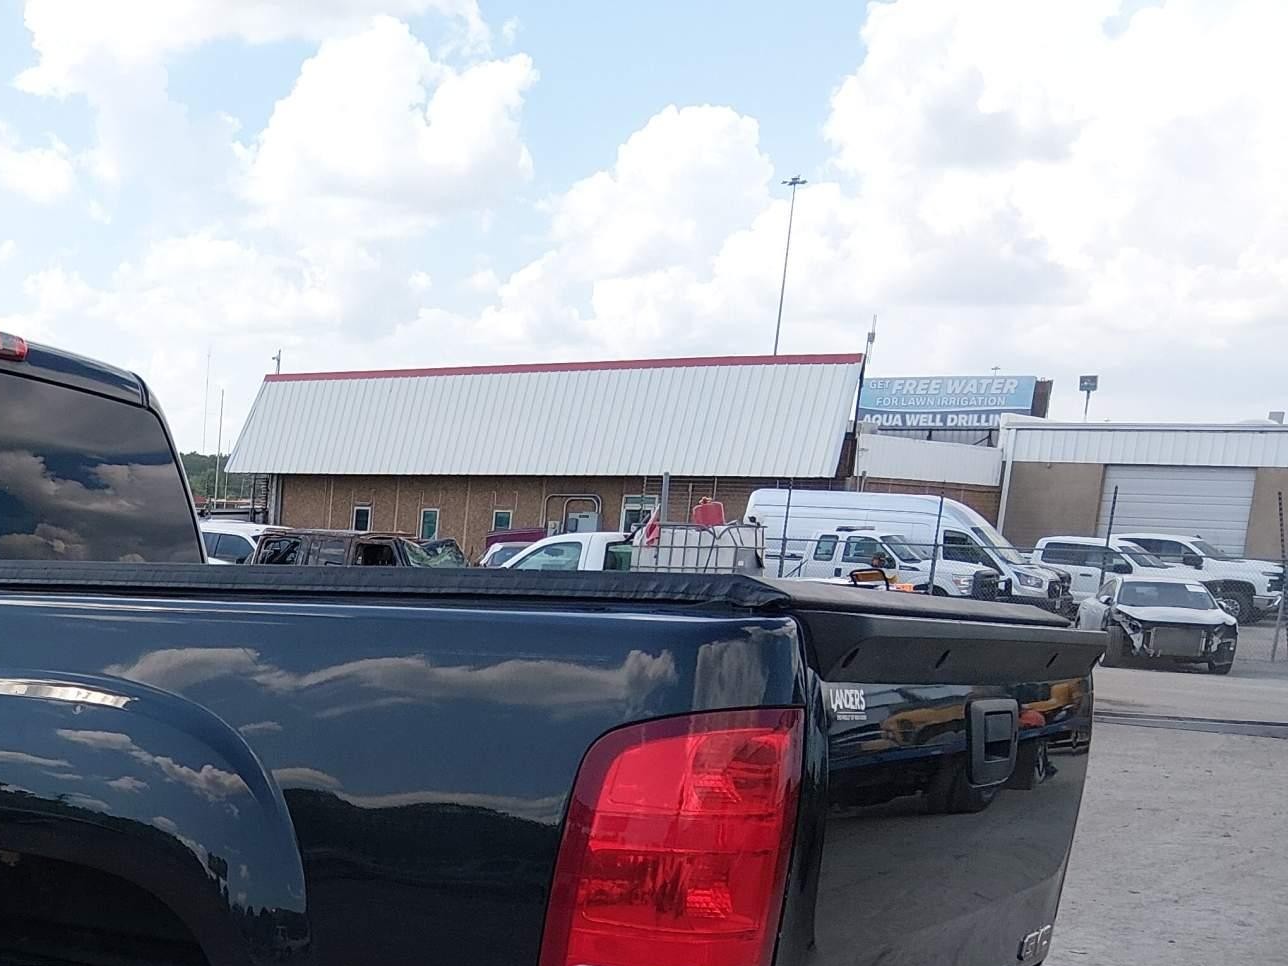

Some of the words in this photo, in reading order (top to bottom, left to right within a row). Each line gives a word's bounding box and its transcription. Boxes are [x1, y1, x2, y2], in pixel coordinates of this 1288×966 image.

[869, 380, 890, 389] GET
[892, 379, 943, 395] FREE
[946, 378, 1018, 394] WATER
[875, 396, 899, 406] FOR
[901, 396, 935, 406] LAWN
[937, 396, 1006, 406] IRRIGATION
[863, 413, 903, 427] AQUA
[905, 414, 944, 427] WELL
[946, 413, 1001, 427] DRILLIN
[829, 688, 866, 712] LANDERS
